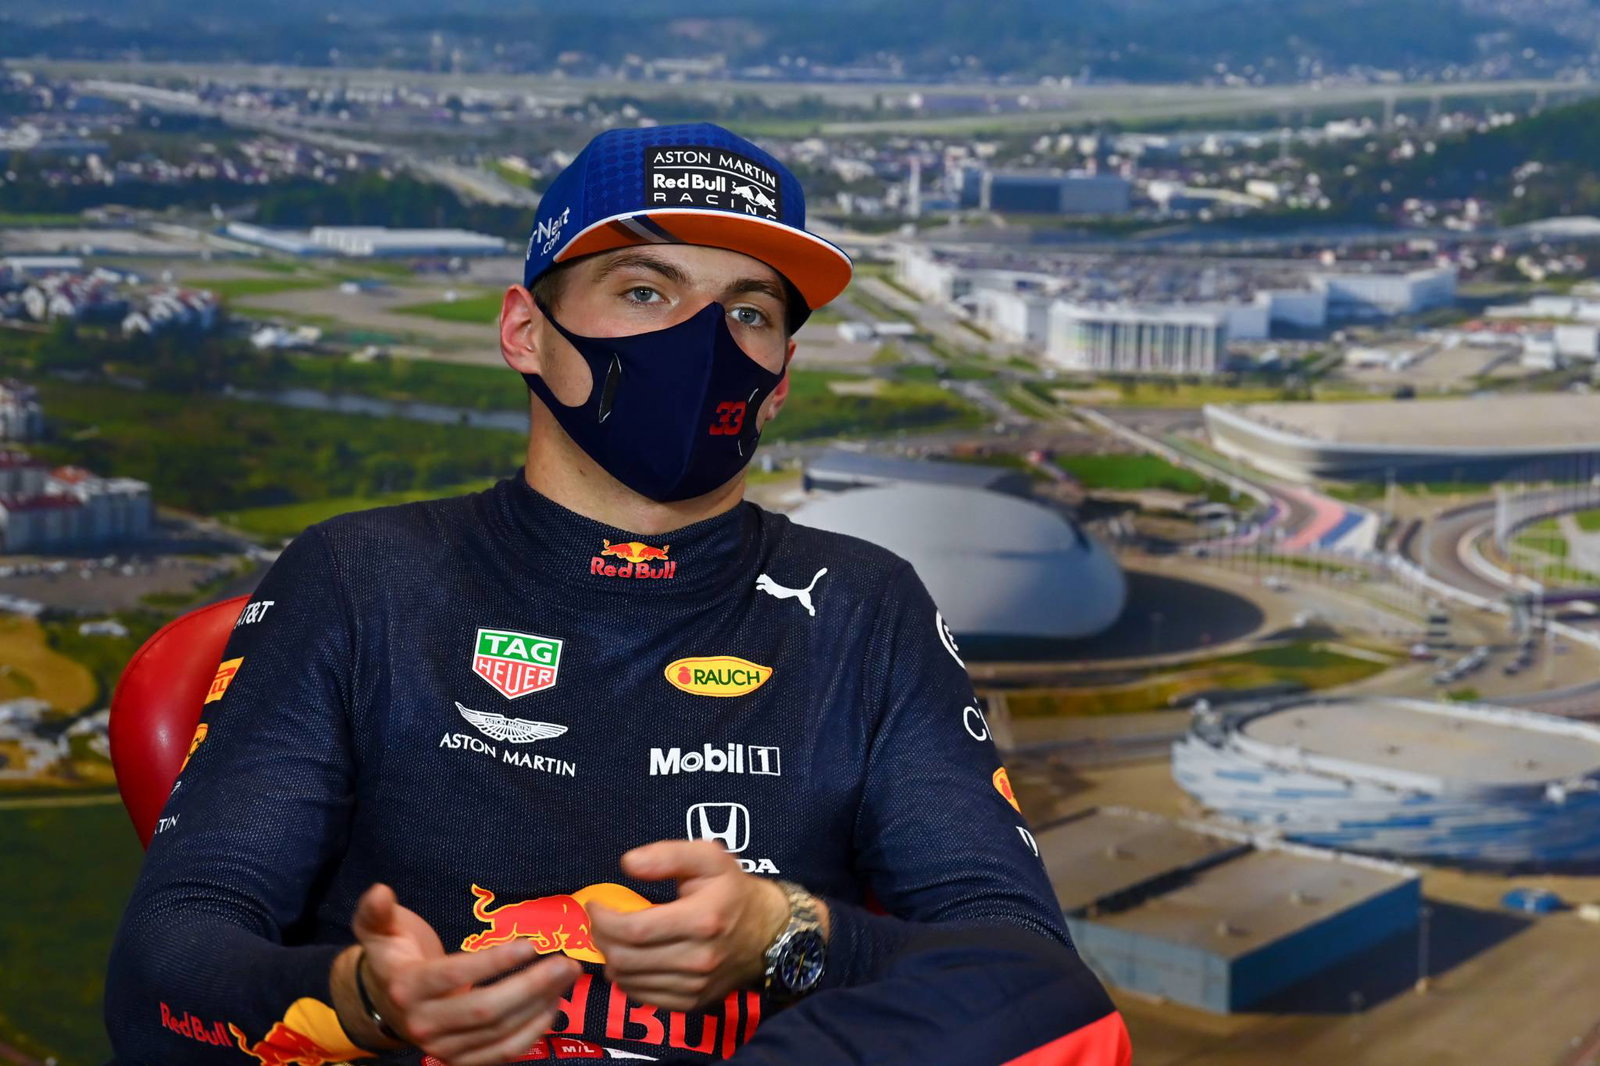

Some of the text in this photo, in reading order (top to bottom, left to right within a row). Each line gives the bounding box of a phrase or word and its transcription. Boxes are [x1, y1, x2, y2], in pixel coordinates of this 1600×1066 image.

[653, 151, 776, 188] ASTON MARTIN
[653, 173, 726, 192] Red Bull
[526, 206, 570, 261] rNext
[709, 401, 746, 435] 33
[591, 556, 677, 579] Red Bull
[484, 634, 553, 663] TAG
[478, 658, 552, 694] HEUER
[694, 668, 760, 685] RAUCH
[439, 732, 576, 777] ASTON MARTIN
[650, 743, 744, 775] Mobil
[154, 813, 180, 834] TIN
[160, 1001, 233, 1047] Red Bull
[561, 1045, 595, 1053] M/L
